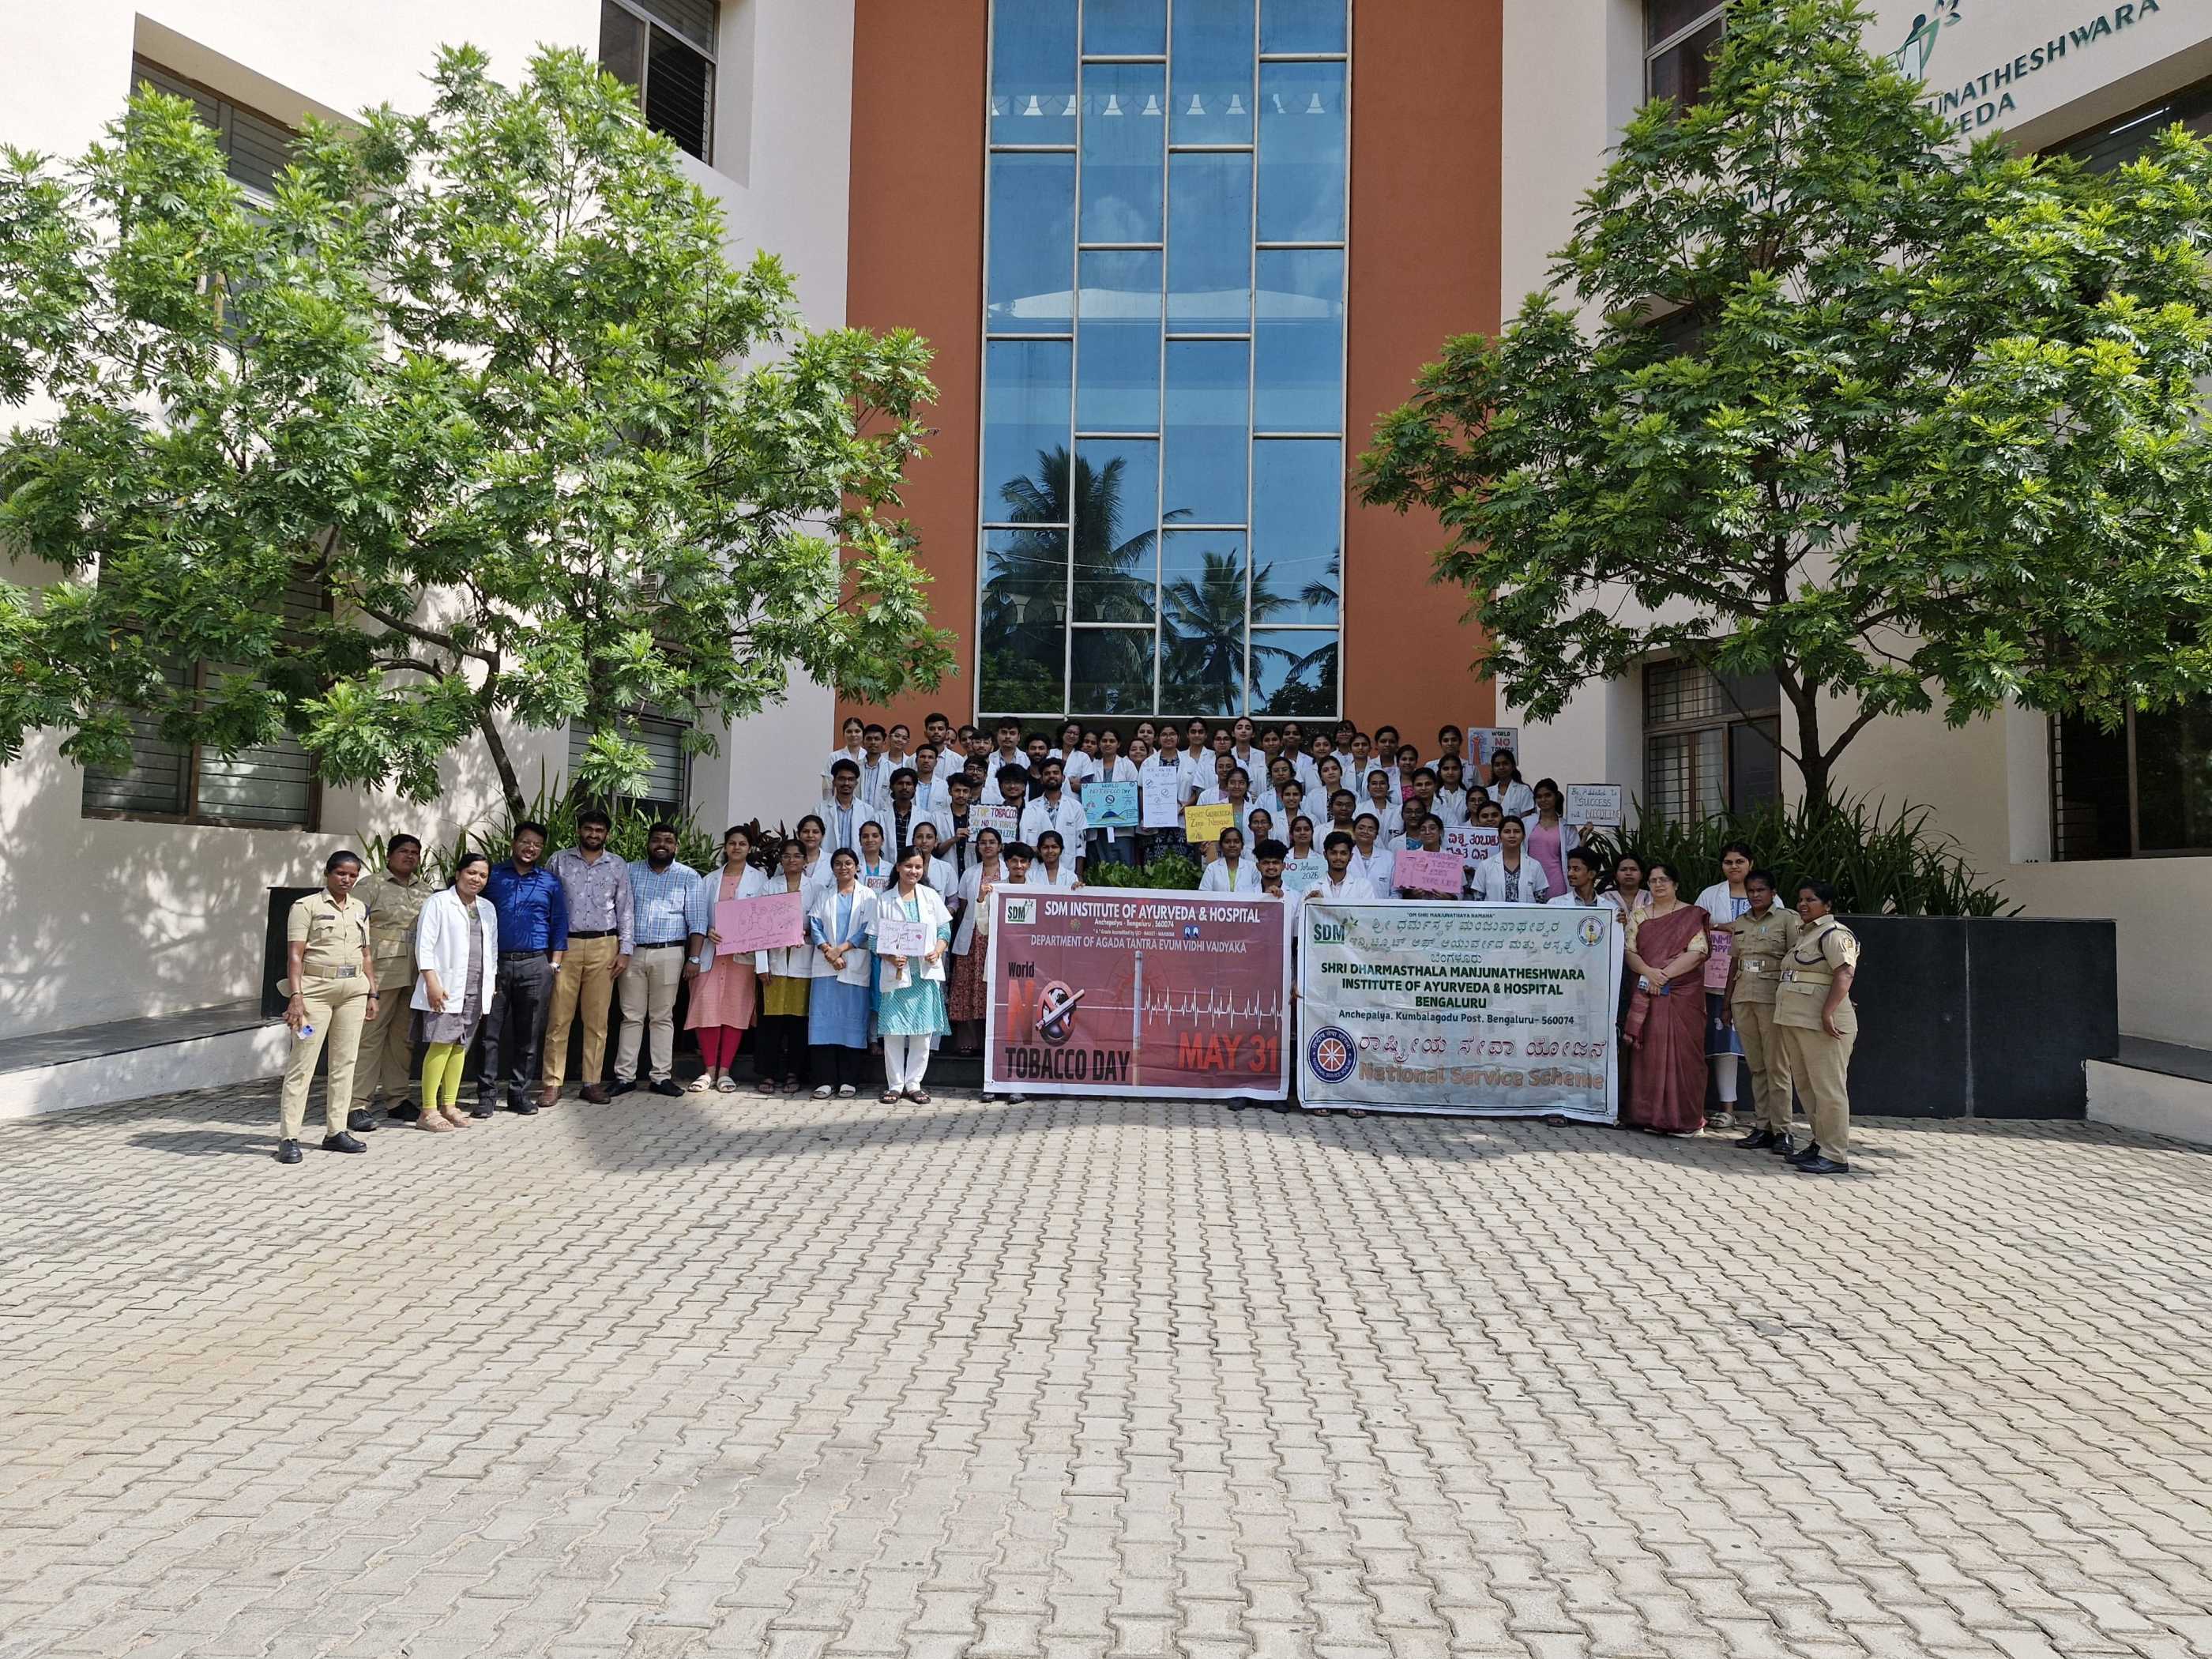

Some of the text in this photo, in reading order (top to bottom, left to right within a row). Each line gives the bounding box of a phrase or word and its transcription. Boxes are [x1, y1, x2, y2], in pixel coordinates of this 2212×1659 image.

[991, 808, 1017, 818] TOBACCO
[1008, 906, 1025, 919] SDM
[1045, 901, 1260, 923] SDM INSTITUTE OF AYURVEDA & HOSPITAL
[1314, 924, 1345, 941] SDM
[1372, 918, 1391, 934] ಶ್ರೀ
[1031, 935, 1247, 954] DEPARTMENT OF AGADA TANTRA EVUM VIDHI VAIDYAKA
[1009, 961, 1034, 978] World
[1322, 962, 1585, 980] SHRI DHARMASTHALA MANJUNATHESHWARA
[1342, 978, 1563, 995] INSTITUTE OF AYURVEDA & HOSPITAL
[1415, 996, 1487, 1009] BENGALURU
[1396, 1011, 1458, 1024] Kumbalagodu
[1541, 1016, 1574, 1025] 560074
[1179, 1031, 1277, 1074] MAY 31
[1358, 1035, 1448, 1063] ರಾಷ್ಟ್ರೀಯ
[1458, 1036, 1515, 1056] ಸೇವಾ
[1006, 1047, 1130, 1082] TOBACCO DAY
[1359, 1061, 1604, 1089] National Service Scheme
